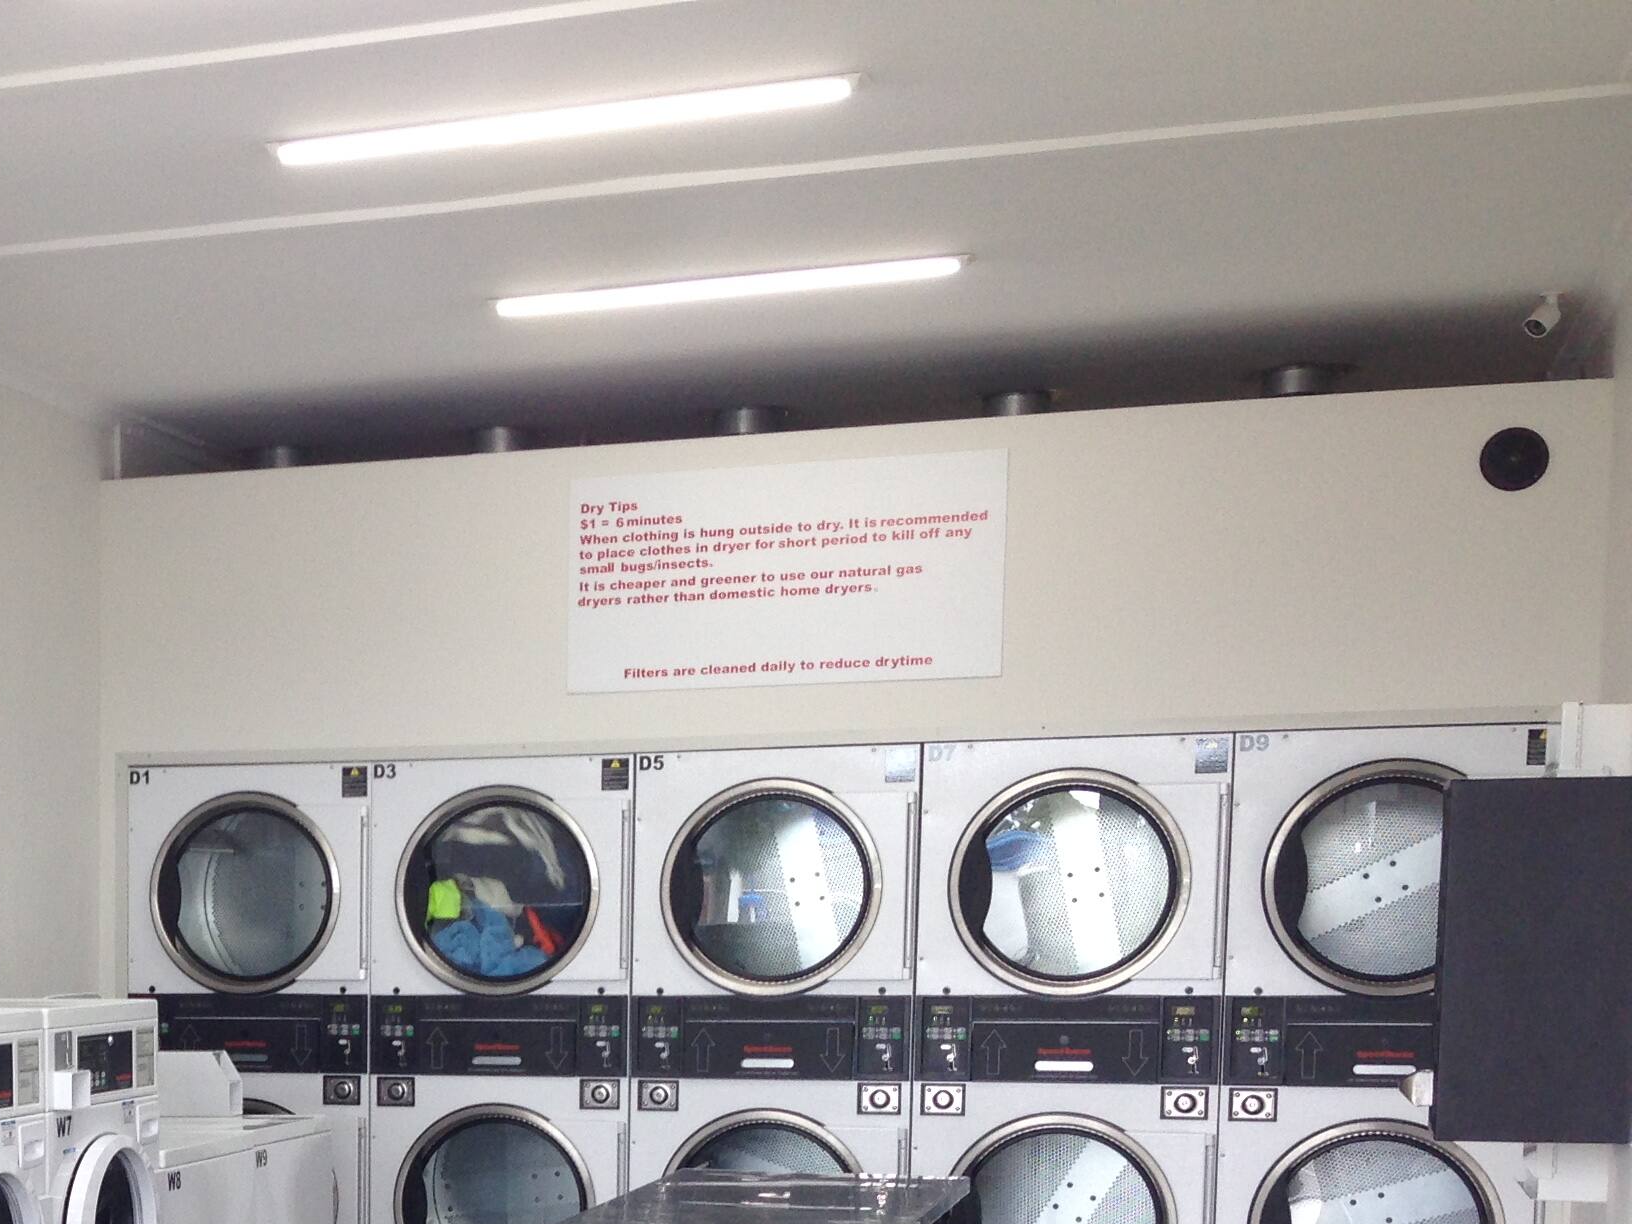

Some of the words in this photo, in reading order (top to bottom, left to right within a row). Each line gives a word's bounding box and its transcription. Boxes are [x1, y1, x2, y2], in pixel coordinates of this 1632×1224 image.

[580, 503, 604, 516] Dry
[608, 501, 638, 513] Tips
[579, 534, 618, 545] When
[622, 530, 678, 542] clothing
[683, 528, 695, 539] is
[699, 527, 734, 538] hung
[739, 522, 793, 535] outside
[797, 521, 812, 532] to
[816, 519, 843, 532] dry.
[848, 518, 859, 528] It
[864, 517, 877, 528] is
[880, 509, 988, 527] recommended
[580, 518, 595, 530] $1
[615, 516, 624, 528] 6
[626, 514, 683, 527] minutes
[578, 550, 593, 560] to
[597, 548, 635, 561] place
[639, 544, 691, 556] clothes
[695, 542, 708, 553] in
[712, 541, 751, 554] dryer
[754, 538, 775, 549] for
[778, 536, 816, 548] short
[821, 532, 867, 548] period
[871, 532, 887, 542] to
[891, 529, 914, 541] kill
[919, 527, 940, 539] off
[944, 528, 972, 539] any
[579, 562, 614, 575] small
[620, 557, 713, 574] bugs/insects.
[579, 581, 589, 592] It
[593, 581, 605, 591] is
[609, 579, 666, 591] cheaper
[670, 575, 696, 587] and
[700, 574, 756, 588] greener
[760, 571, 775, 582] to
[779, 571, 805, 581] use
[810, 570, 834, 579] our
[838, 564, 891, 578] natural
[895, 565, 923, 577] gas
[577, 596, 622, 608] dryers
[626, 593, 669, 604] rather
[673, 591, 705, 602] than
[709, 586, 775, 600] domestic
[780, 585, 820, 596] home
[623, 667, 668, 679] Filters
[672, 667, 696, 676] are
[700, 661, 756, 675] cleaned
[760, 660, 795, 673] daily
[799, 659, 814, 670] to
[819, 657, 870, 669] reduce
[874, 655, 933, 669] drytime
[1239, 734, 1269, 752] D9
[928, 744, 956, 762] D7
[373, 763, 396, 779] D3
[639, 754, 664, 771] D5
[129, 769, 150, 785] D1
[57, 1115, 72, 1138] W7
[255, 1149, 268, 1168] W9
[168, 1171, 182, 1191] W8
